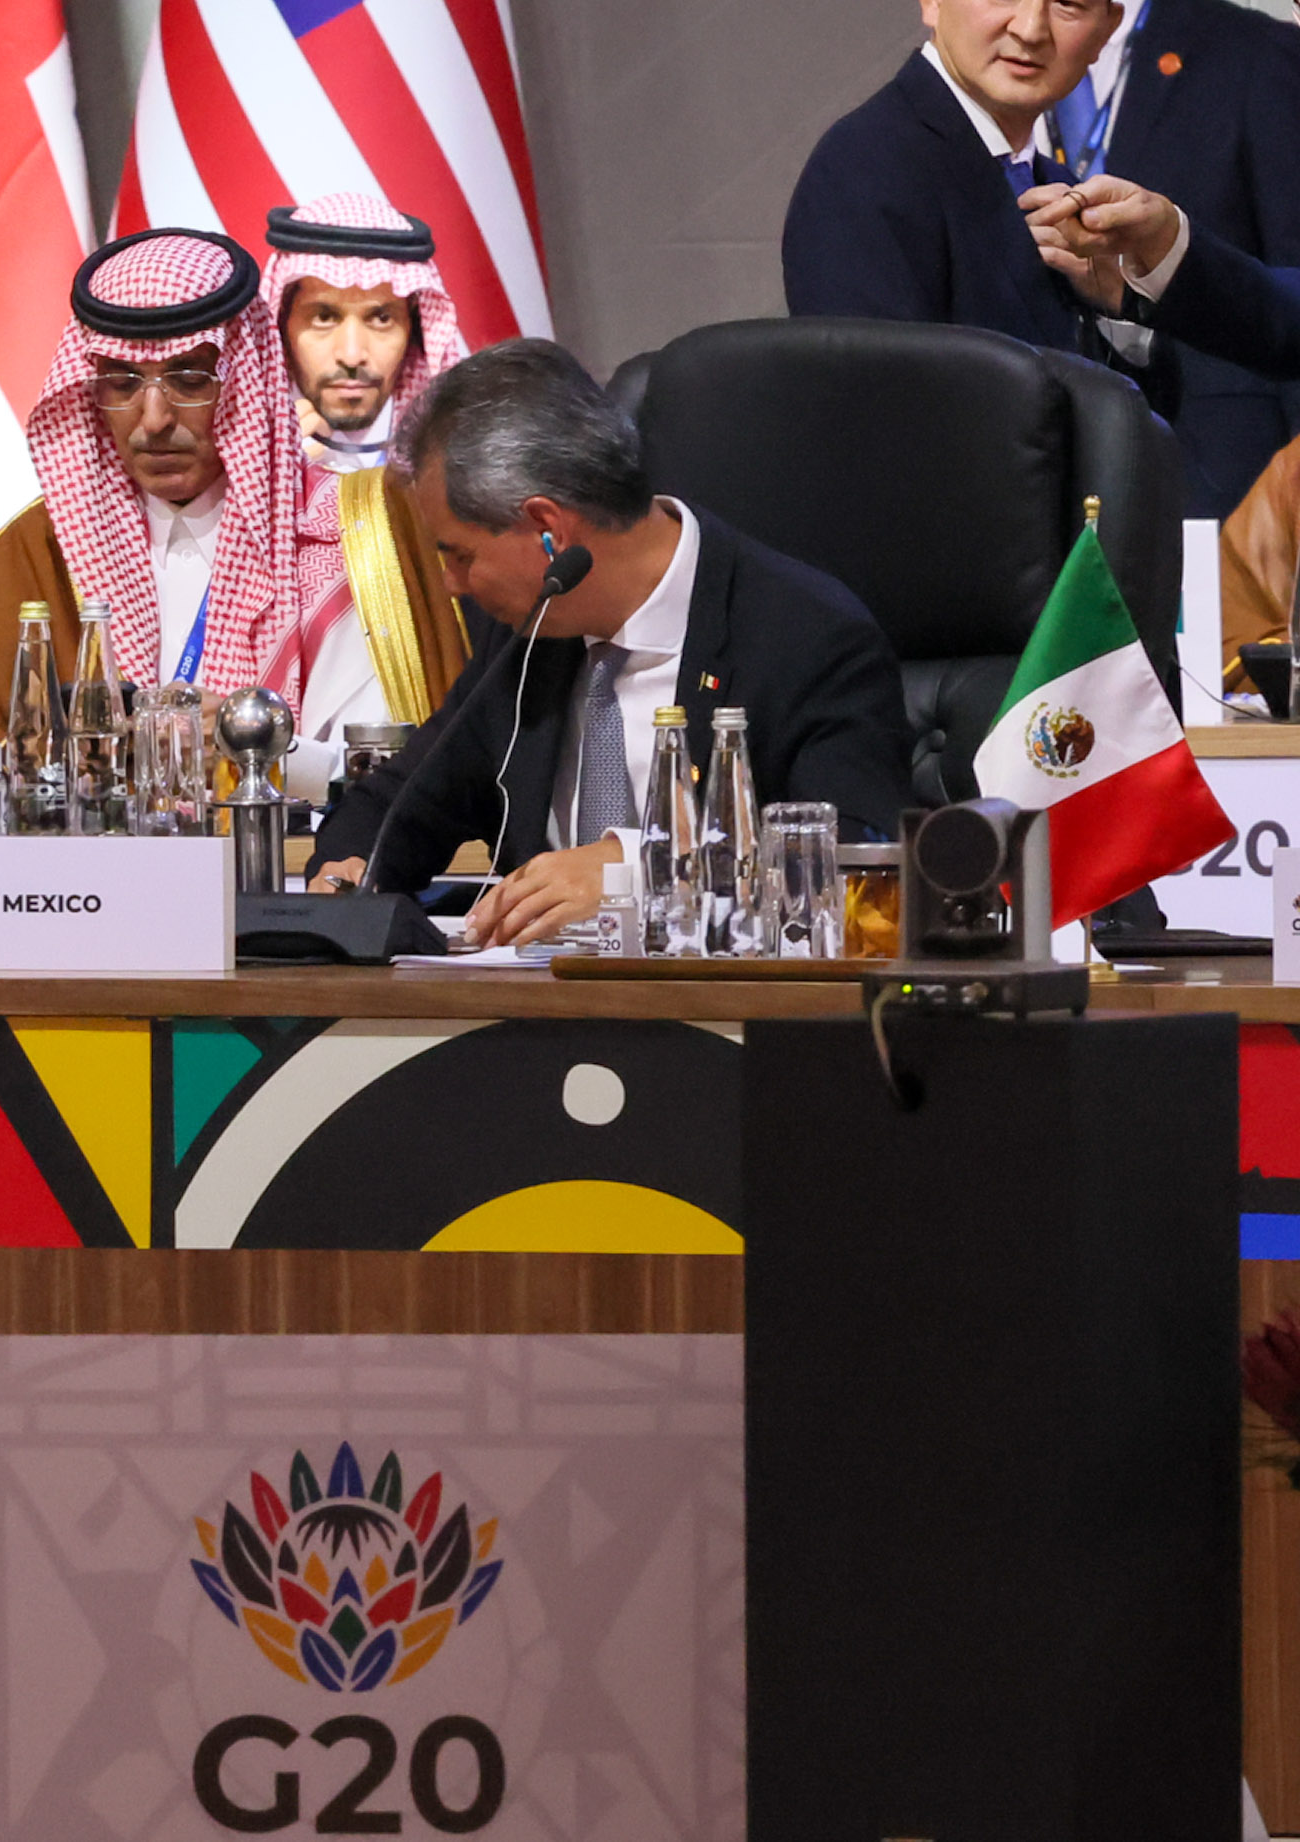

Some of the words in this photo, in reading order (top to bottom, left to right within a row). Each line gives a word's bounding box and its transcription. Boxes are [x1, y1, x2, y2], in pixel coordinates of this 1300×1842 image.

[1167, 819, 1290, 877] 20
[3, 894, 102, 913] MEXICO
[192, 1714, 506, 1834] G20
